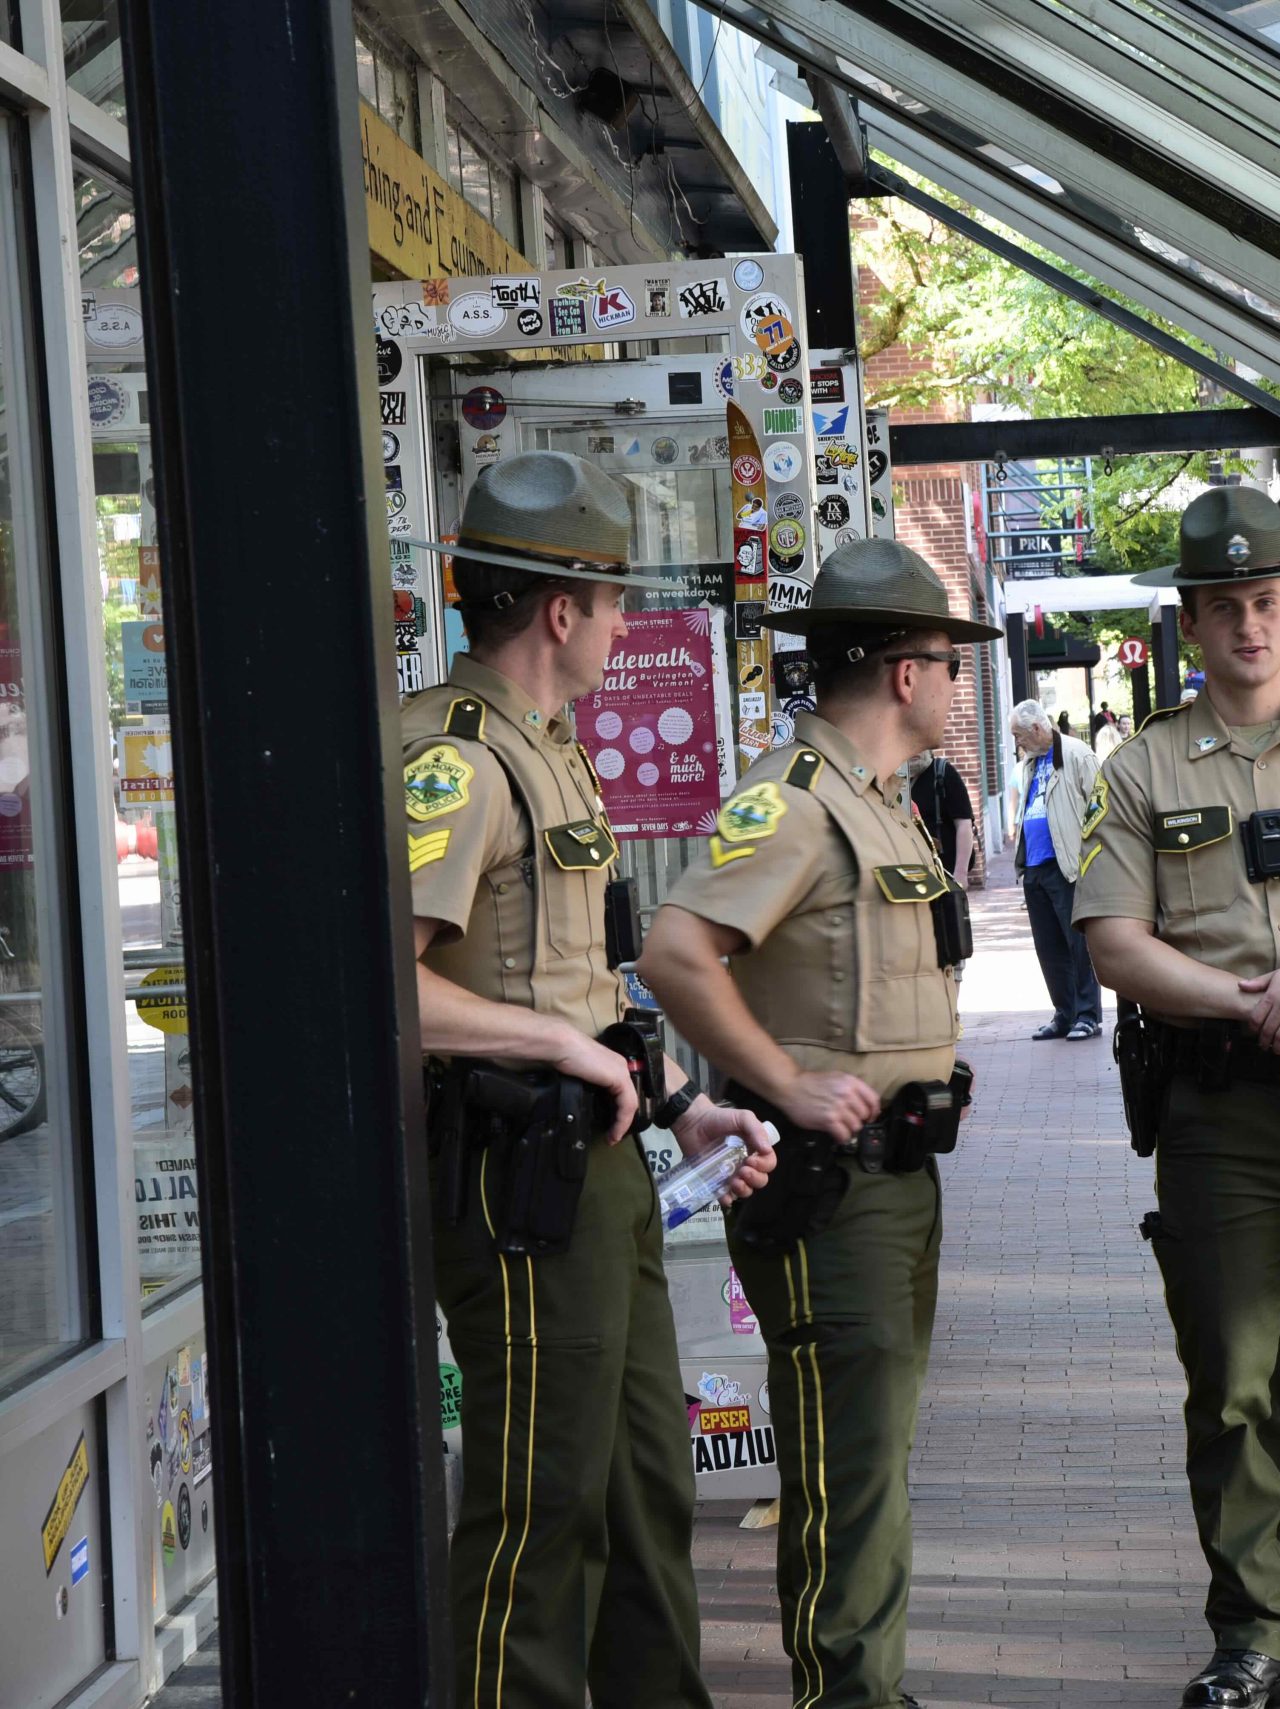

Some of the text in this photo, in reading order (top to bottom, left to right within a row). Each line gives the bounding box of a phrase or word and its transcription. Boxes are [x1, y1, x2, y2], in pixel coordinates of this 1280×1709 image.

[406, 174, 433, 245] and
[462, 310, 492, 320] A.S.S.
[598, 310, 631, 324] HICKMAN
[763, 320, 784, 344] 77
[704, 574, 723, 584] AM
[645, 588, 720, 600] on weekdays.
[594, 671, 694, 692] ale Burlington
[652, 680, 694, 688] Vermont
[592, 694, 602, 708] 5
[774, 712, 789, 722] BODY
[670, 751, 697, 764] & so
[411, 763, 461, 775] VERMONT
[671, 770, 705, 783] more!
[425, 792, 458, 811] POLICE
[1167, 816, 1198, 826] WILKINSON
[701, 1409, 750, 1430] EPSER
